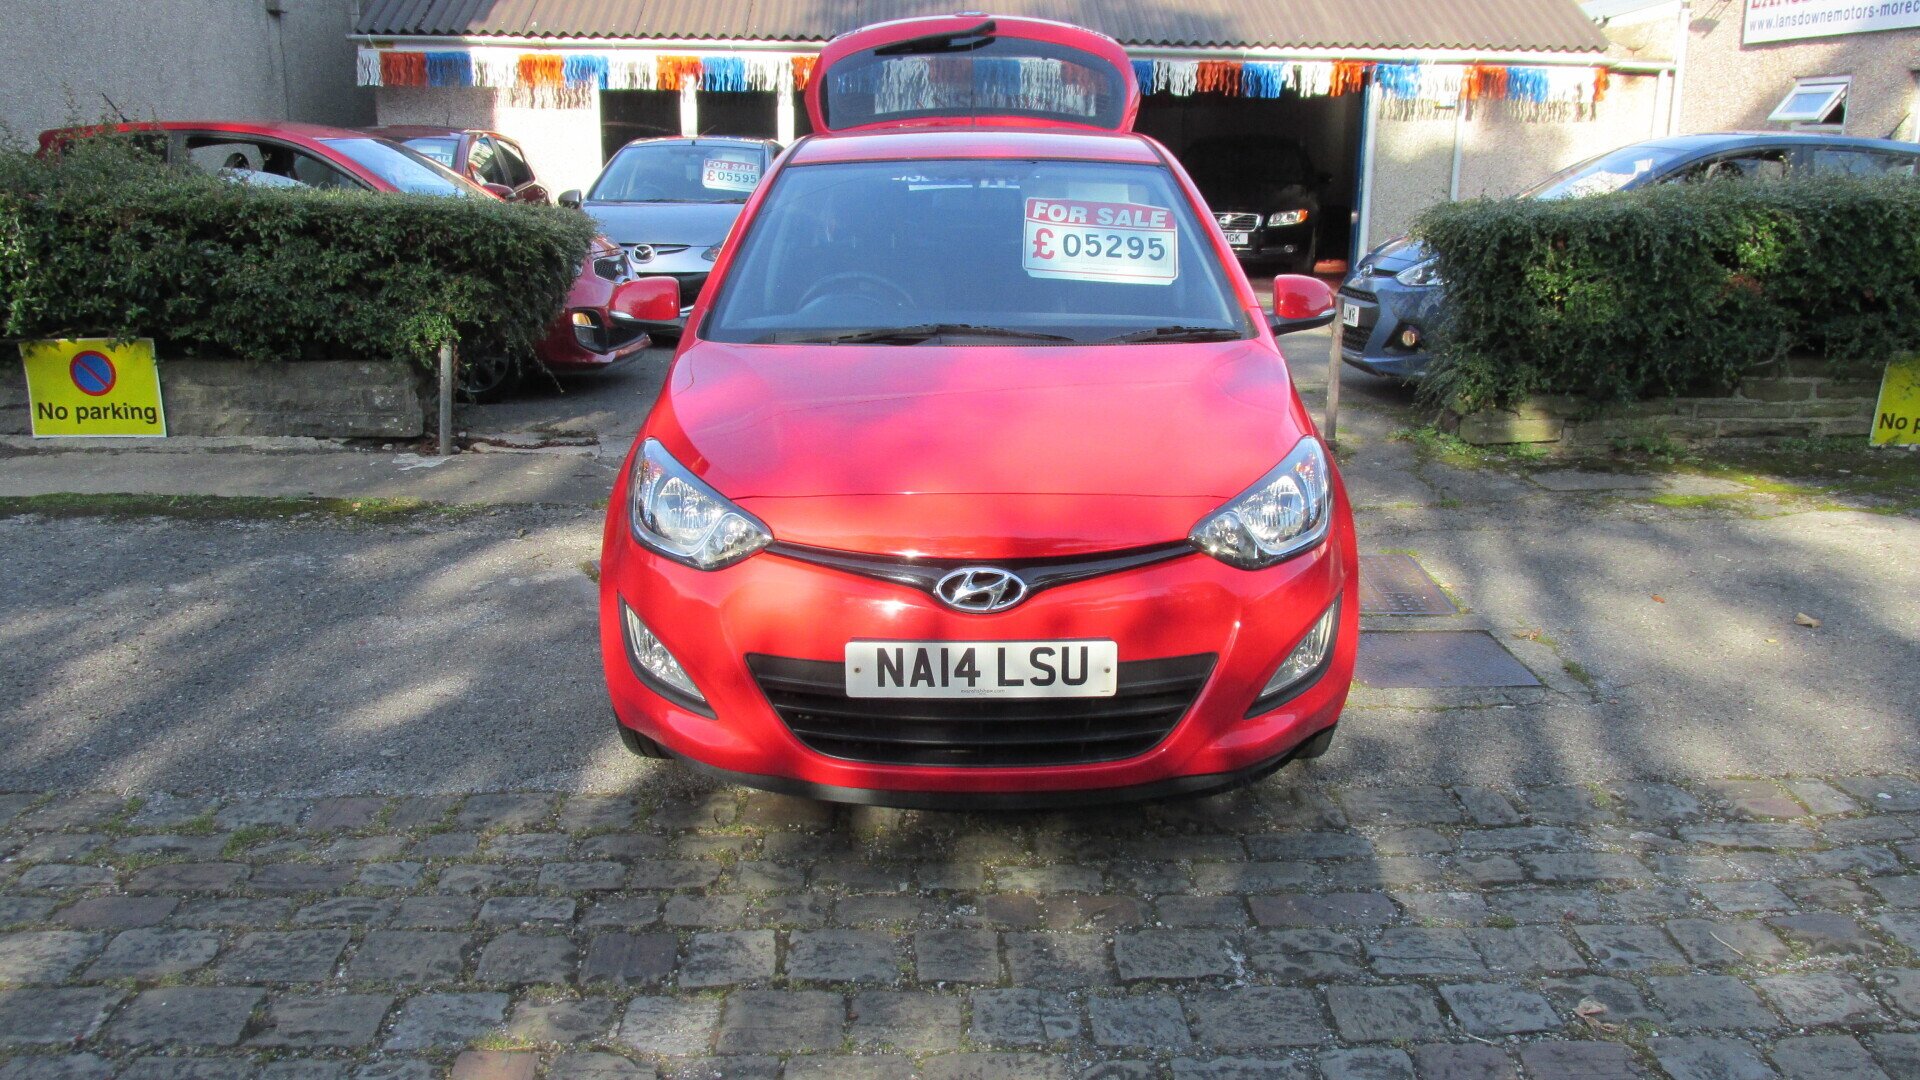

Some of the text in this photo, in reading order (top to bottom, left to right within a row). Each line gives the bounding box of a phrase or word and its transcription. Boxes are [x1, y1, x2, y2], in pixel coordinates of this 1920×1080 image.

[708, 161, 729, 169] FOR
[718, 172, 757, 183] 05595
[1033, 201, 1167, 228] FOR SALE
[1063, 234, 1165, 261] 05295
[38, 402, 157, 424] No parking
[1879, 413, 1908, 430] No
[877, 646, 1088, 687] NA14 LSU
